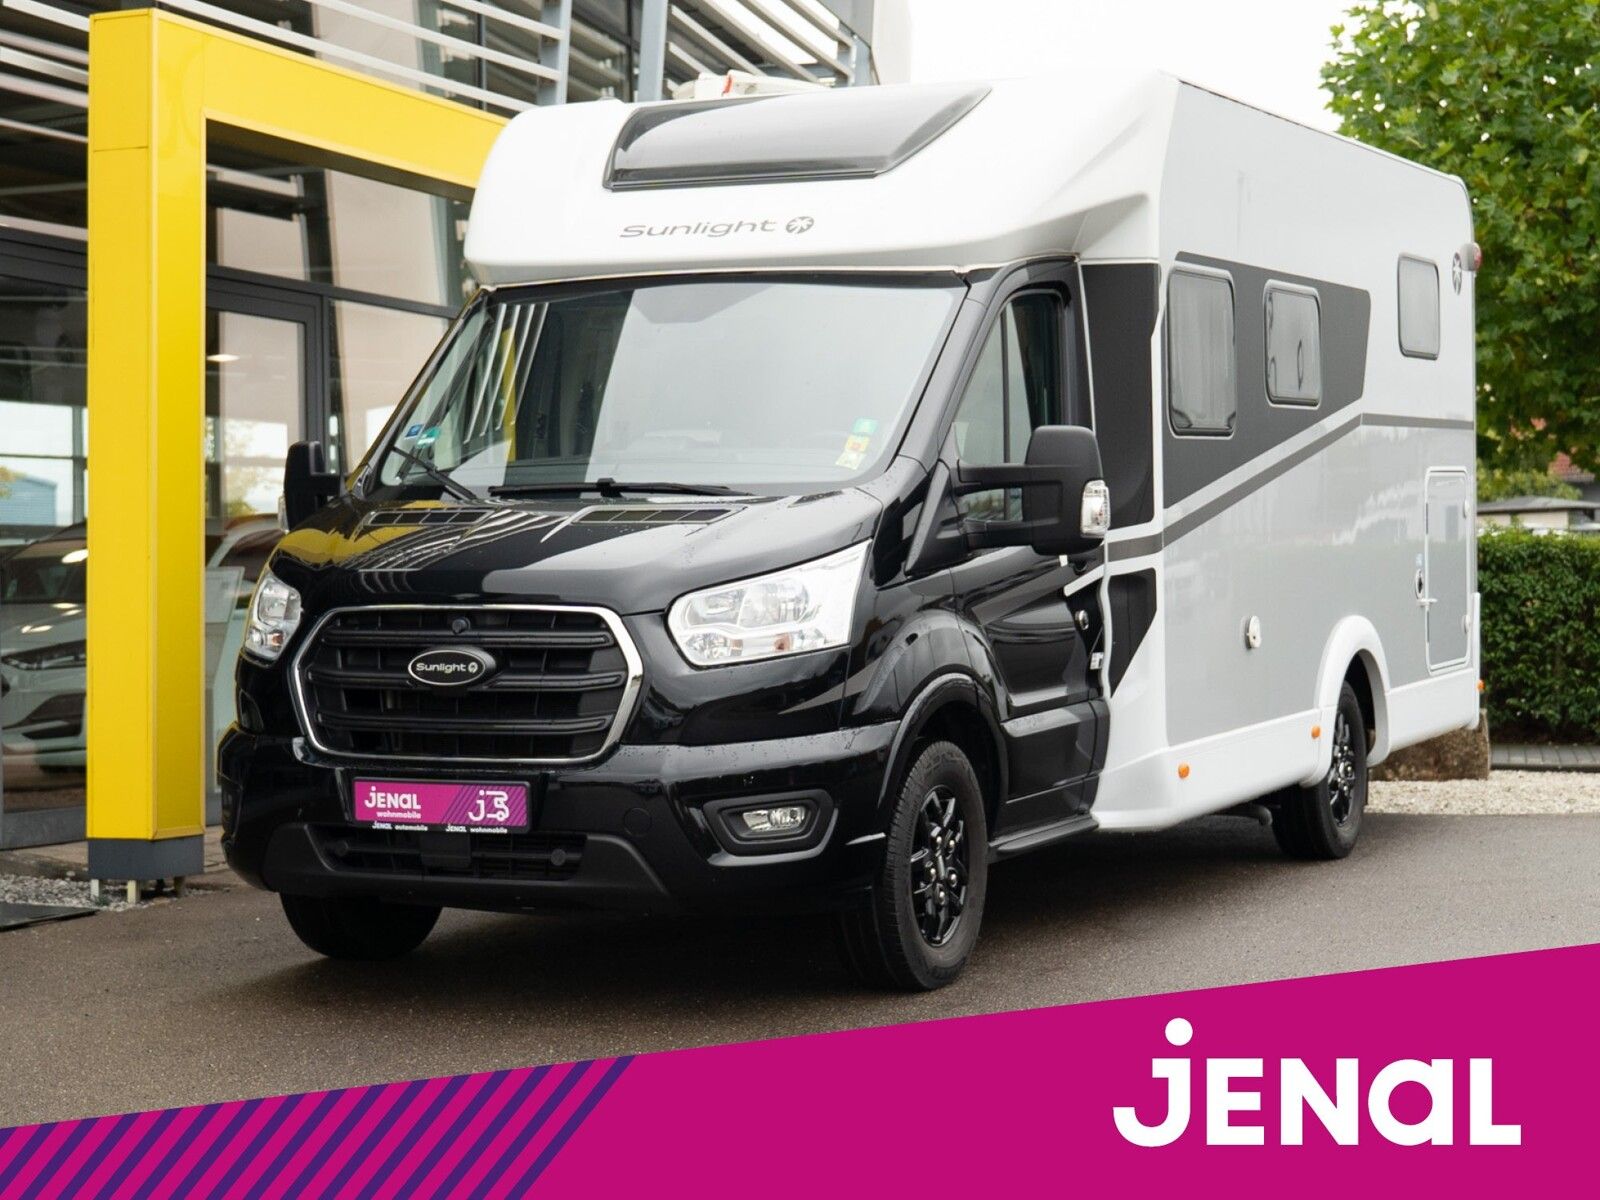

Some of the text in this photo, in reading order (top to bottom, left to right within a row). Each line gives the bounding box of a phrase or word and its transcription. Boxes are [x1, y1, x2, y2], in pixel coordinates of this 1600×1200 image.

[620, 218, 776, 237] Sunlight
[416, 662, 466, 674] Sunlight
[376, 811, 421, 819] wohnmobile
[395, 824, 428, 832] automobile
